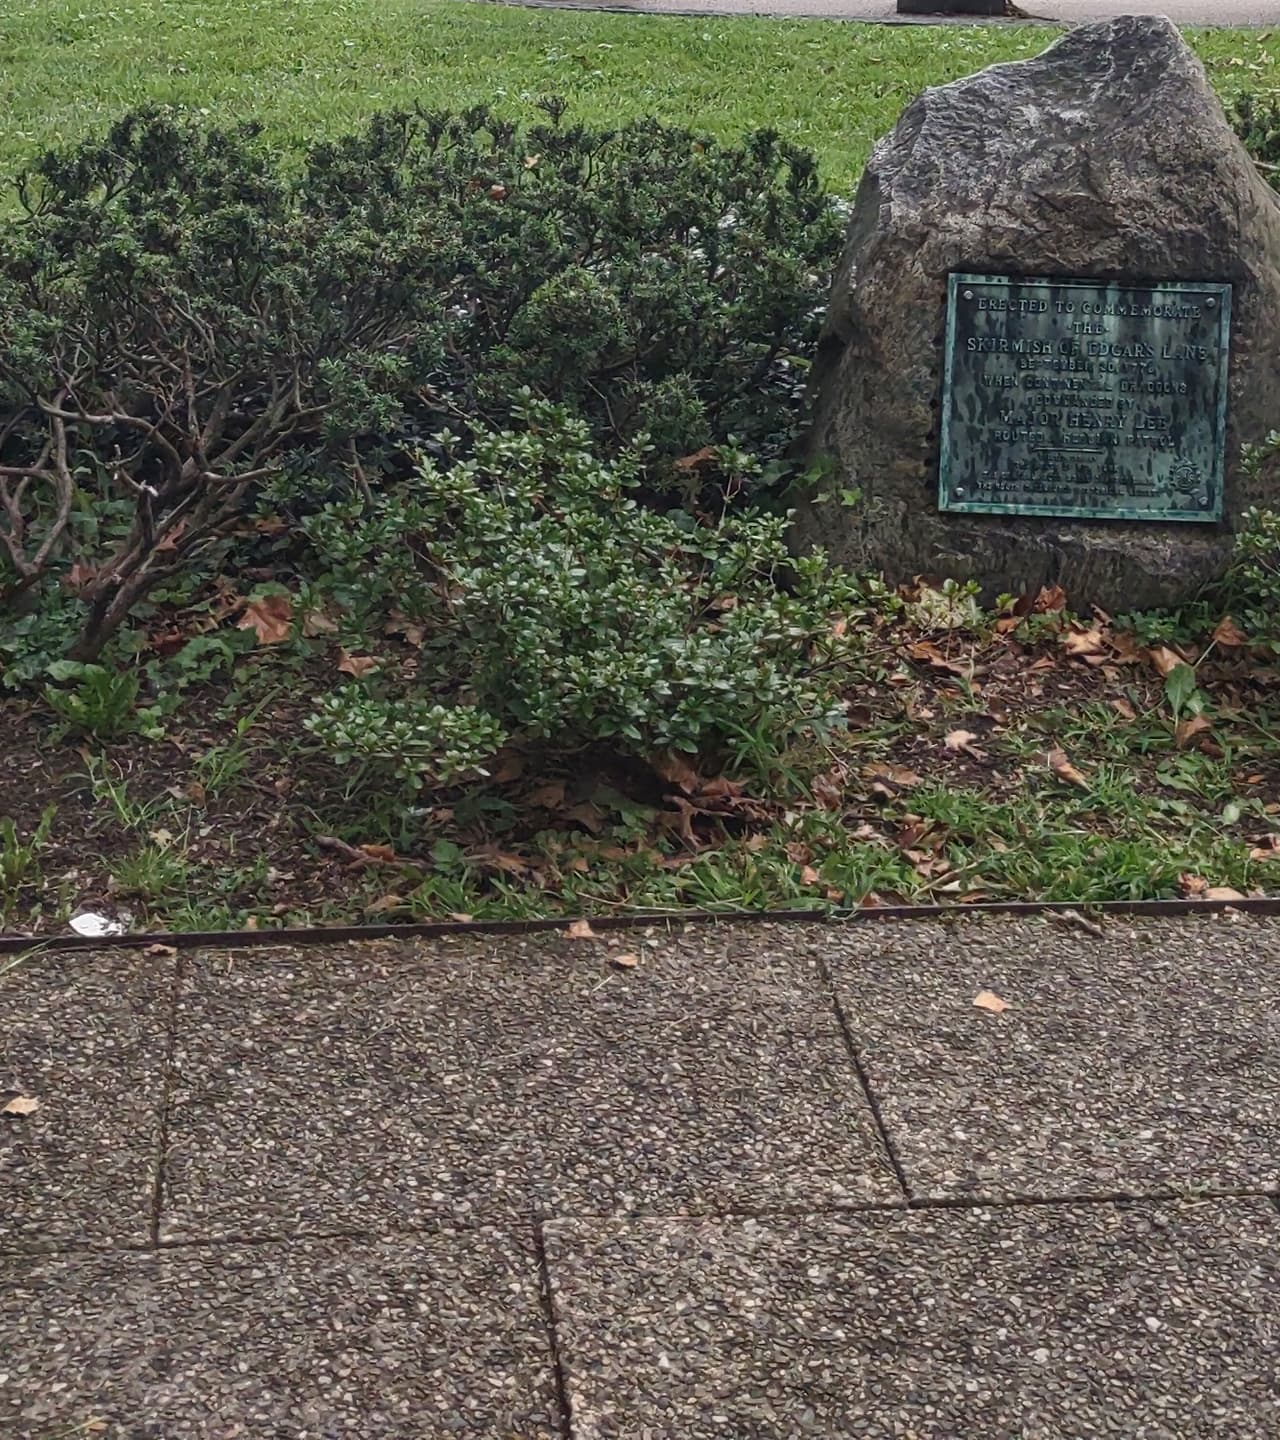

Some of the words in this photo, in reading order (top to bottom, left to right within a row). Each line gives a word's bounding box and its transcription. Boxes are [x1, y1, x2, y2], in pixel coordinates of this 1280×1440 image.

[977, 298, 1048, 312] ERECTED
[1055, 300, 1076, 313] TO
[1081, 301, 1201, 318] COMMEMORATE
[966, 338, 1053, 355] SKIRMISH
[1060, 340, 1081, 356] OF
[1087, 342, 1155, 357] EDGAR'S
[1068, 412, 1128, 428] HENRY
[1135, 414, 1170, 430] LEE
